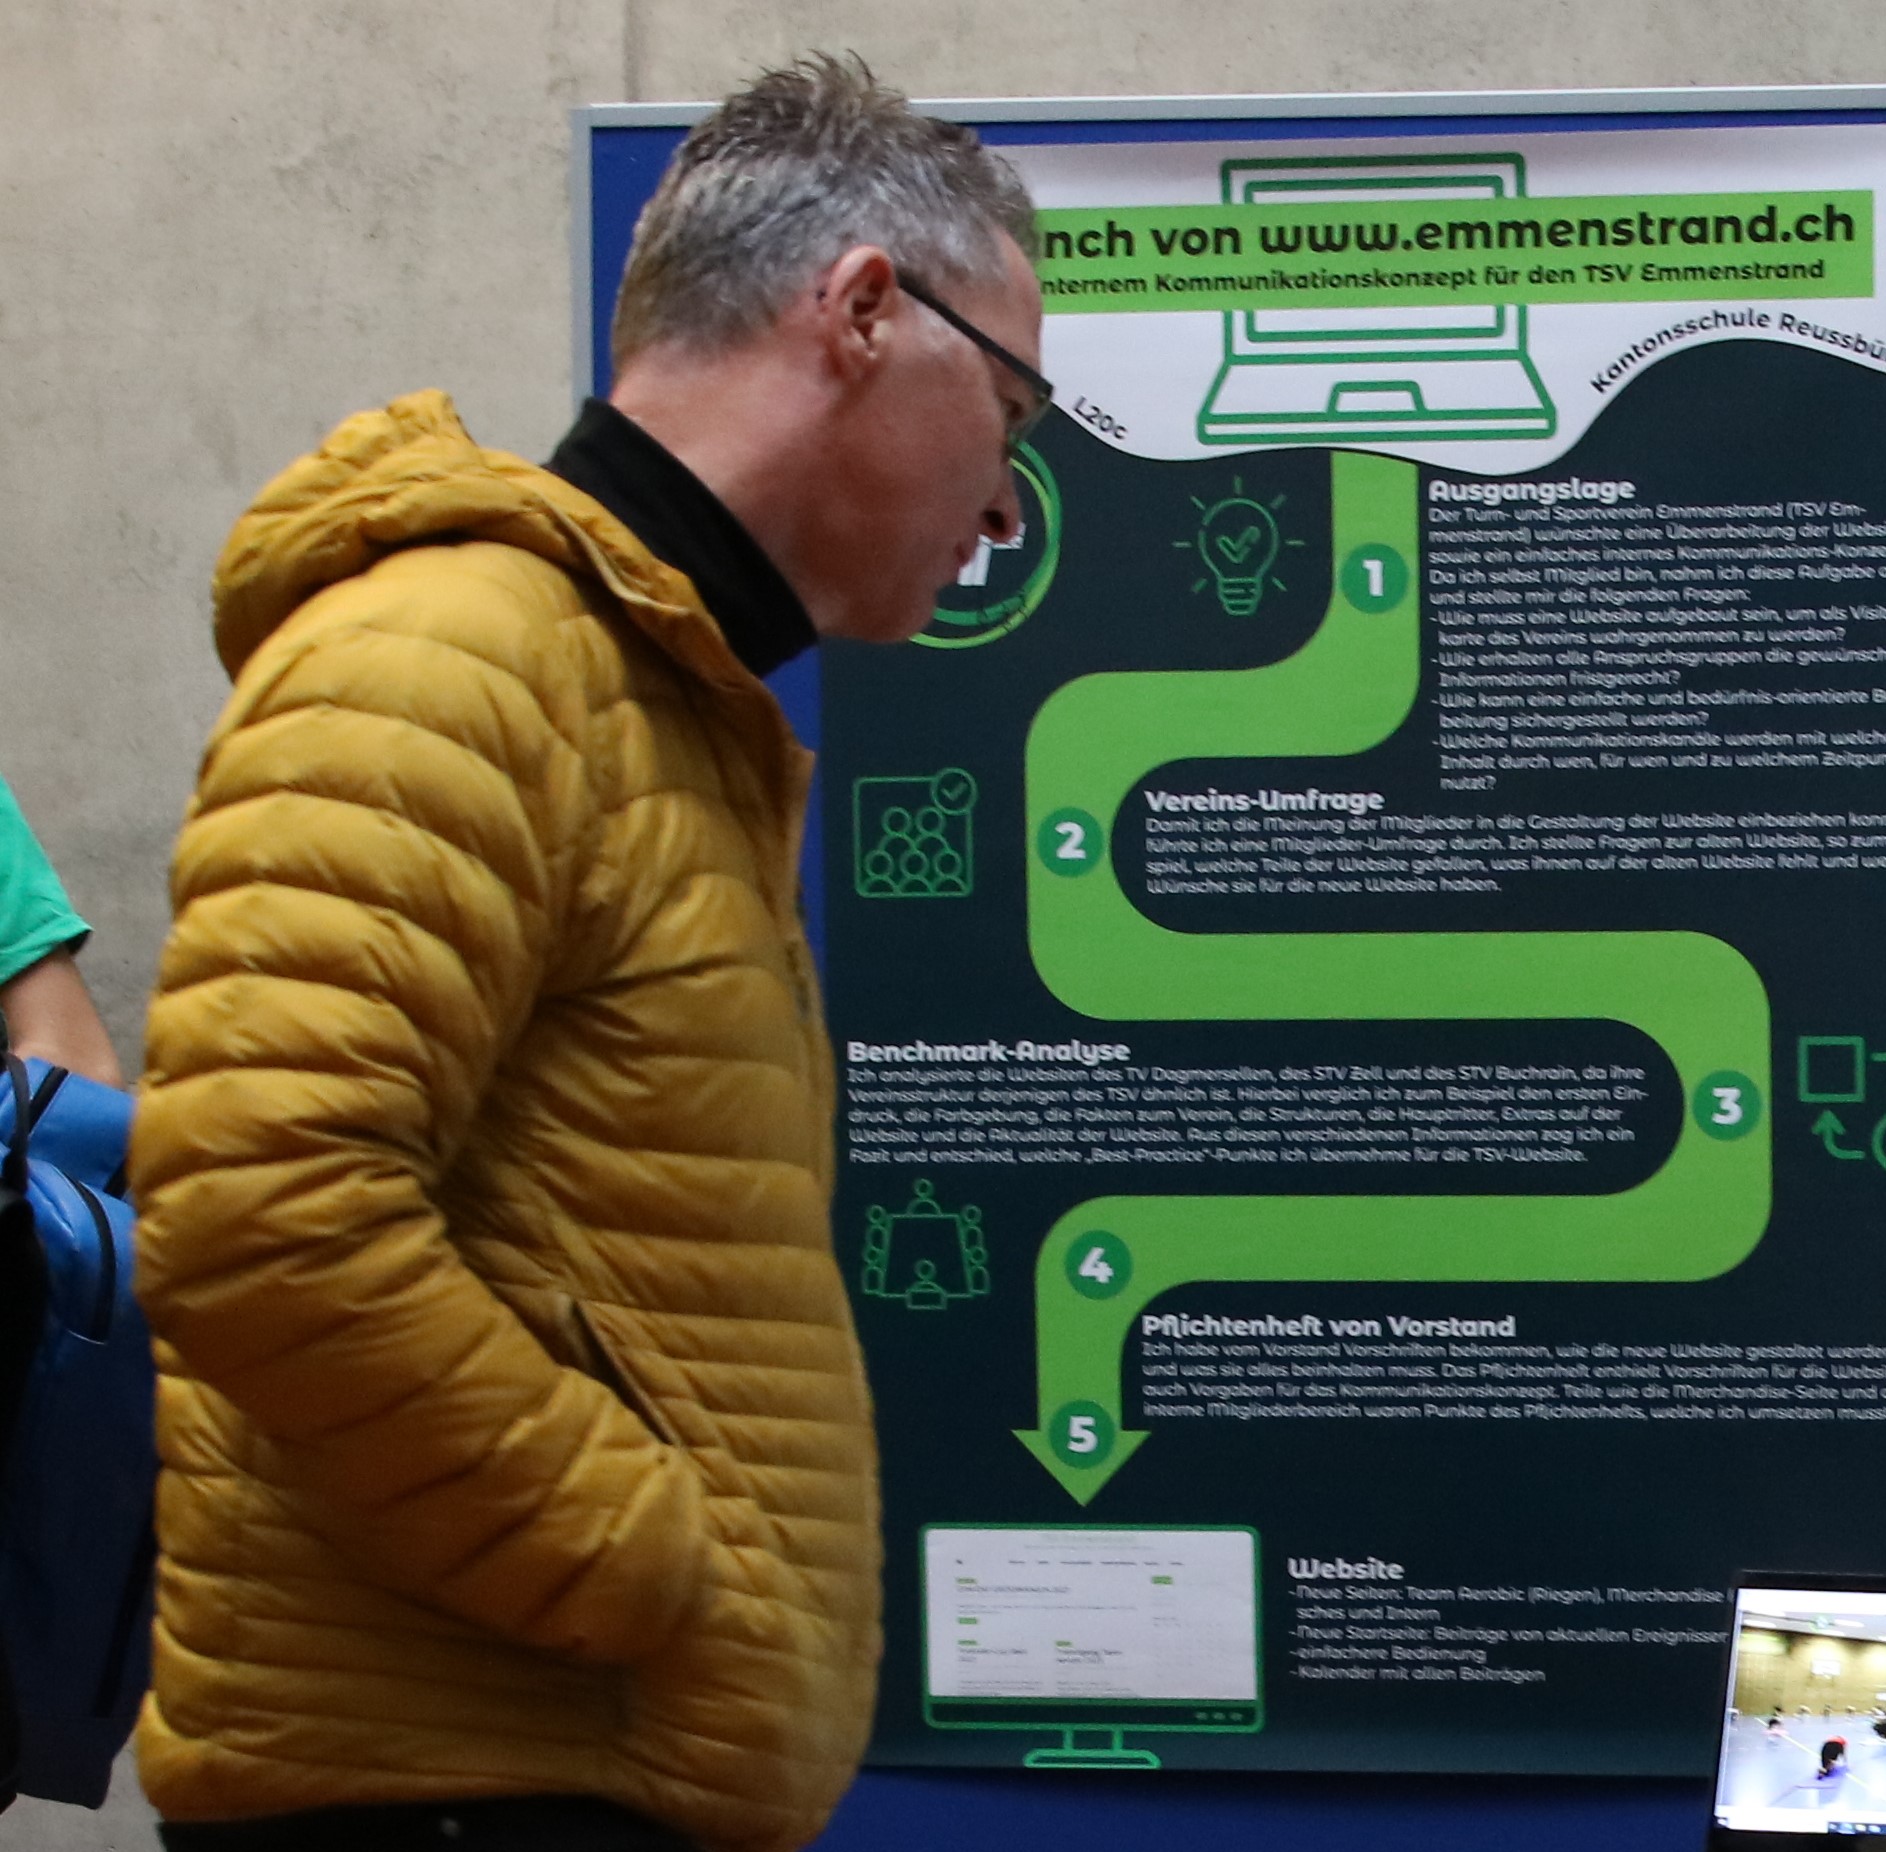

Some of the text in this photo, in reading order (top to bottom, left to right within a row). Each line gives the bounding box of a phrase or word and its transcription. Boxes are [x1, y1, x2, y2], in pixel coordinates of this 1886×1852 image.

[1150, 226, 1242, 256] von
[1260, 203, 1854, 253] www.emmenstrand.ch
[1041, 259, 1826, 295] nternem Kommunikationskonzept für den TSV Emmenstrand
[1590, 307, 1770, 394] Kantonsschule
[1073, 395, 1128, 440] L20c
[1428, 478, 1636, 505] Ausgangslage
[1427, 505, 1459, 521] Der
[1515, 504, 1550, 520] und
[1799, 523, 1828, 539] der
[1484, 547, 1511, 563] ein
[1361, 559, 1384, 597] 1
[1144, 788, 1385, 815] Vereins-Umfrage
[1055, 821, 1087, 860] 2
[847, 1040, 1131, 1066] Benchmark-Analyse
[1711, 1087, 1743, 1125] 3
[1078, 1247, 1115, 1284] 4
[1141, 1315, 1517, 1339] Pflichtenheft von Vorstand
[1067, 1415, 1098, 1453] 5
[1288, 1556, 1405, 1580] Website
